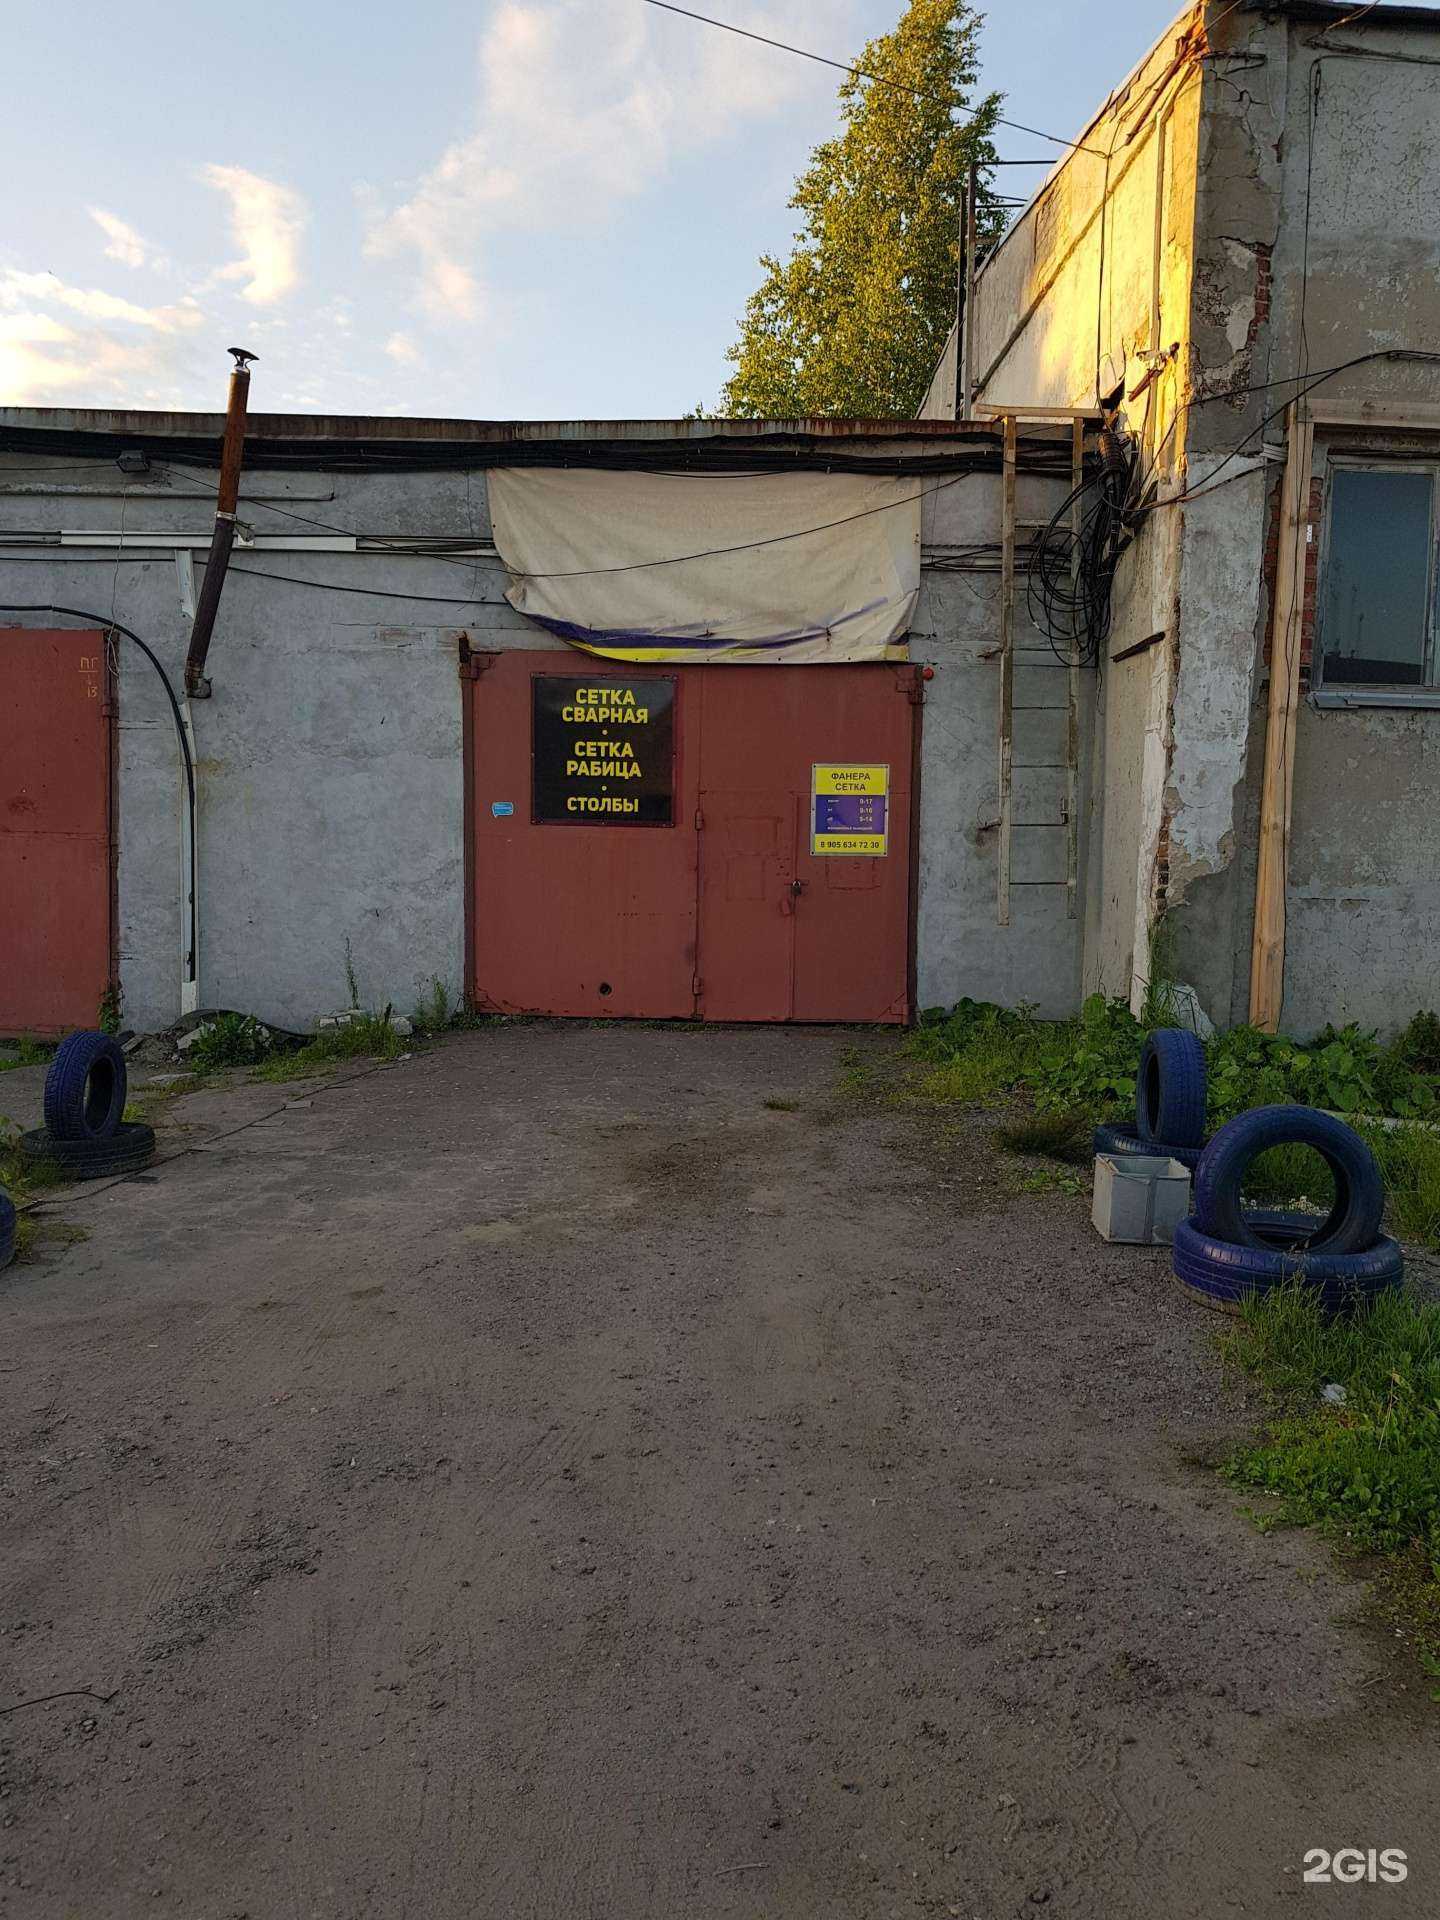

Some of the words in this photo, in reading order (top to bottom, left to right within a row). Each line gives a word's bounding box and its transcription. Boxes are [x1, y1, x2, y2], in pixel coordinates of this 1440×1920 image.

[575, 688, 636, 705] СЕТКА
[562, 706, 649, 724] СВАРНАЯ
[574, 741, 634, 758] СЕТКА
[566, 760, 642, 780] РАБИЦА
[831, 772, 871, 781] ФАНЕРА
[835, 782, 866, 791] СЕТКА
[566, 797, 639, 813] СТОЛБЫ
[827, 841, 841, 849] 905
[843, 841, 857, 849] 634
[859, 841, 869, 849] 72
